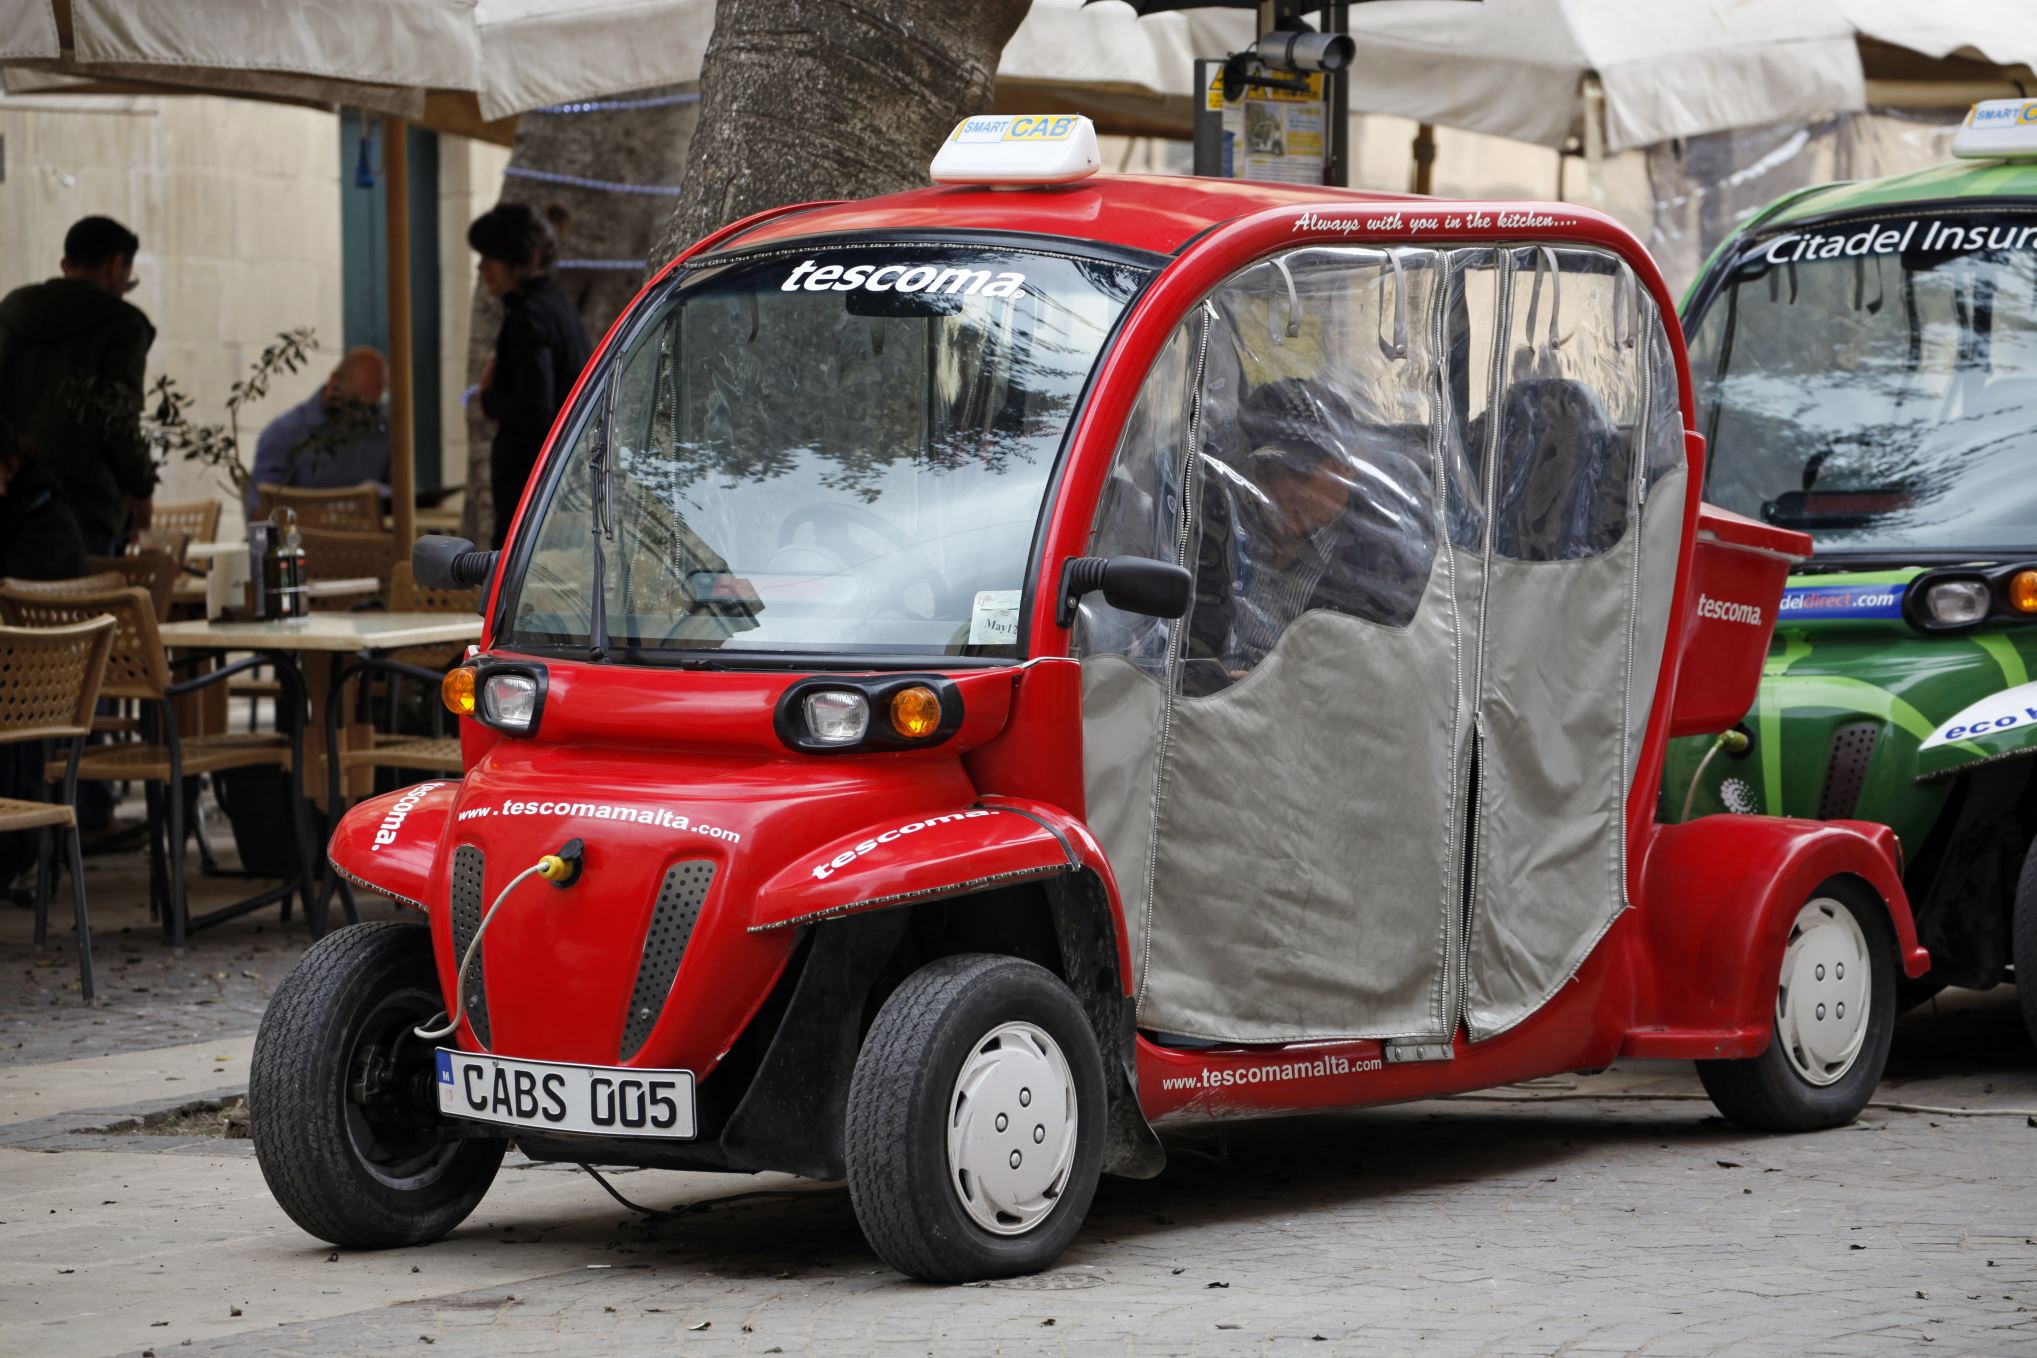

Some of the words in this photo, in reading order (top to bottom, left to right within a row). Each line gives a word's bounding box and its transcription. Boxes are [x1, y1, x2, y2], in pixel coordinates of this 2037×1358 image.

[964, 121, 1009, 133] SMART
[1010, 118, 1072, 137] CAB
[1976, 108, 2018, 120] SMART
[1292, 212, 1360, 236] Always
[1366, 212, 1403, 231] with
[1409, 216, 1438, 235] you
[1444, 214, 1461, 229] in
[1466, 210, 1492, 229] the
[1766, 221, 1918, 264] Citadel
[1921, 221, 2037, 251] Insur
[1162, 1055, 1382, 1090] www.tescomamalta.com
[463, 1063, 567, 1122] CABS
[590, 1077, 677, 1128] 005
